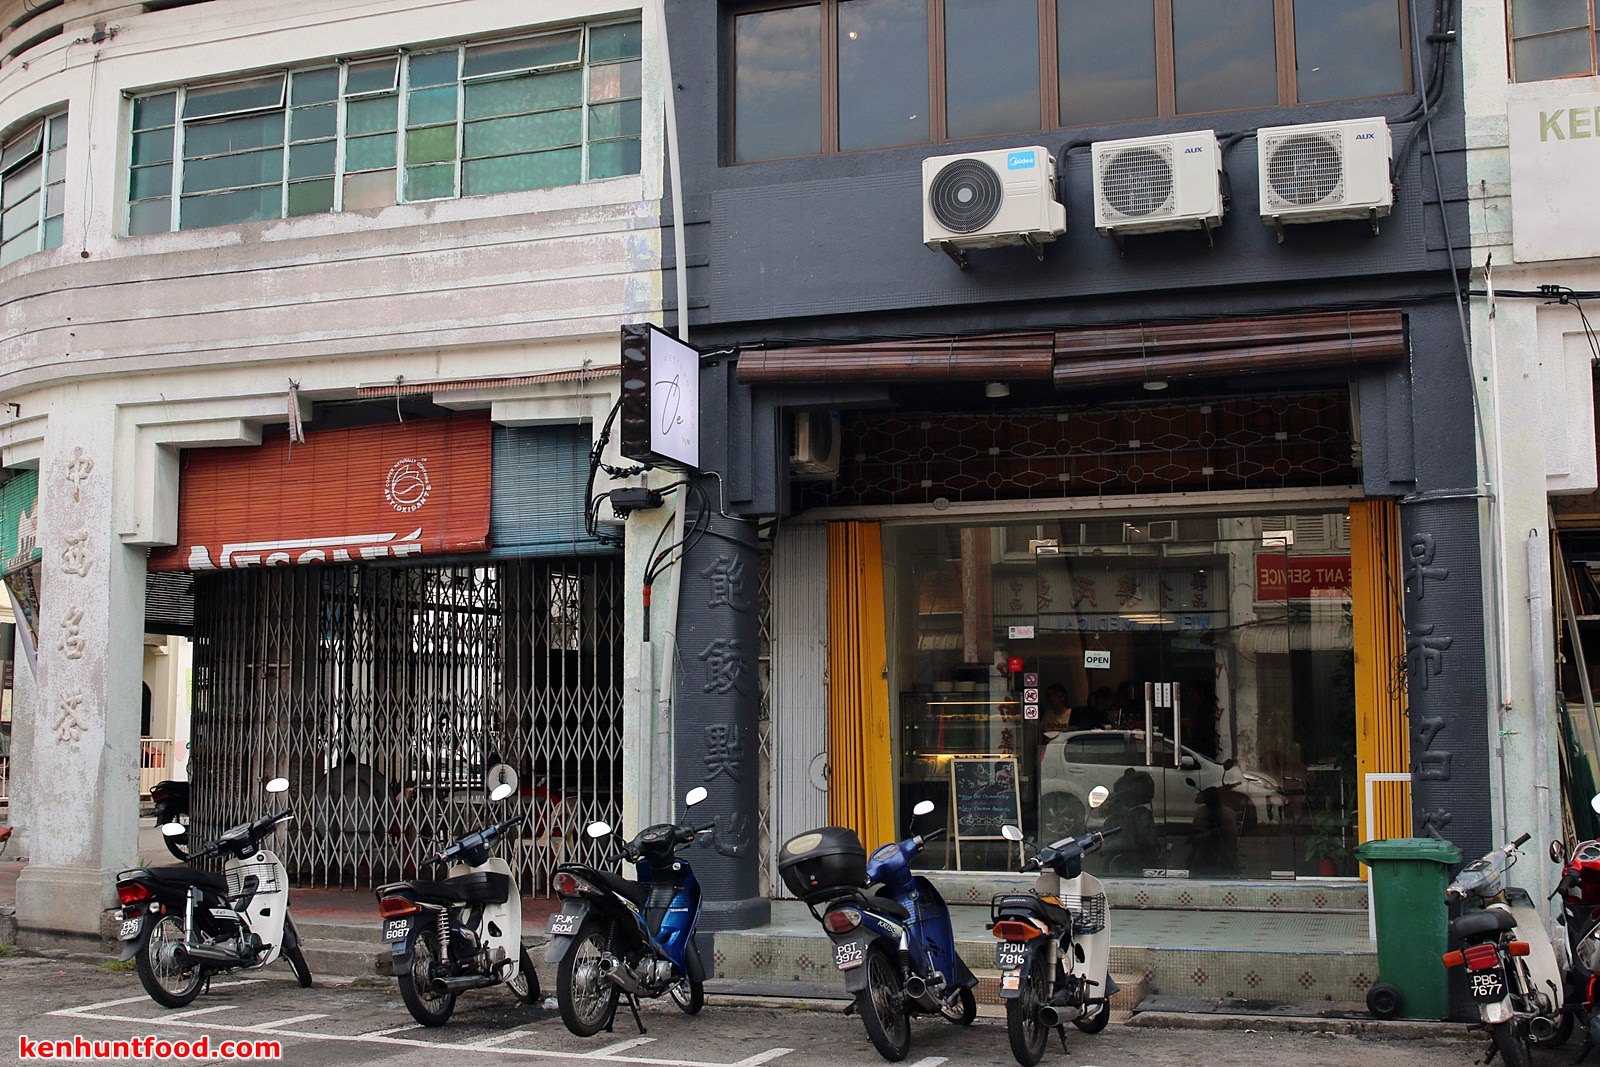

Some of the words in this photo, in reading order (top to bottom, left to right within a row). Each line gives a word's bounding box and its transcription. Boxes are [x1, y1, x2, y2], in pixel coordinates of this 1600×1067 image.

[1539, 106, 1600, 142] KE
[1184, 146, 1203, 154] AUX
[1009, 156, 1034, 167] Midea
[1086, 656, 1109, 664] OPEN
[390, 919, 407, 930] PGB
[556, 915, 574, 923] PJK
[120, 925, 139, 936] 6731
[386, 928, 410, 939] 6087
[552, 924, 573, 932] 1604
[837, 942, 857, 955] PGT
[1003, 943, 1025, 953] PDU
[836, 950, 863, 964] 3972
[1000, 953, 1025, 964] 7816
[1473, 974, 1498, 986] PBC
[1471, 984, 1502, 997] 7677
